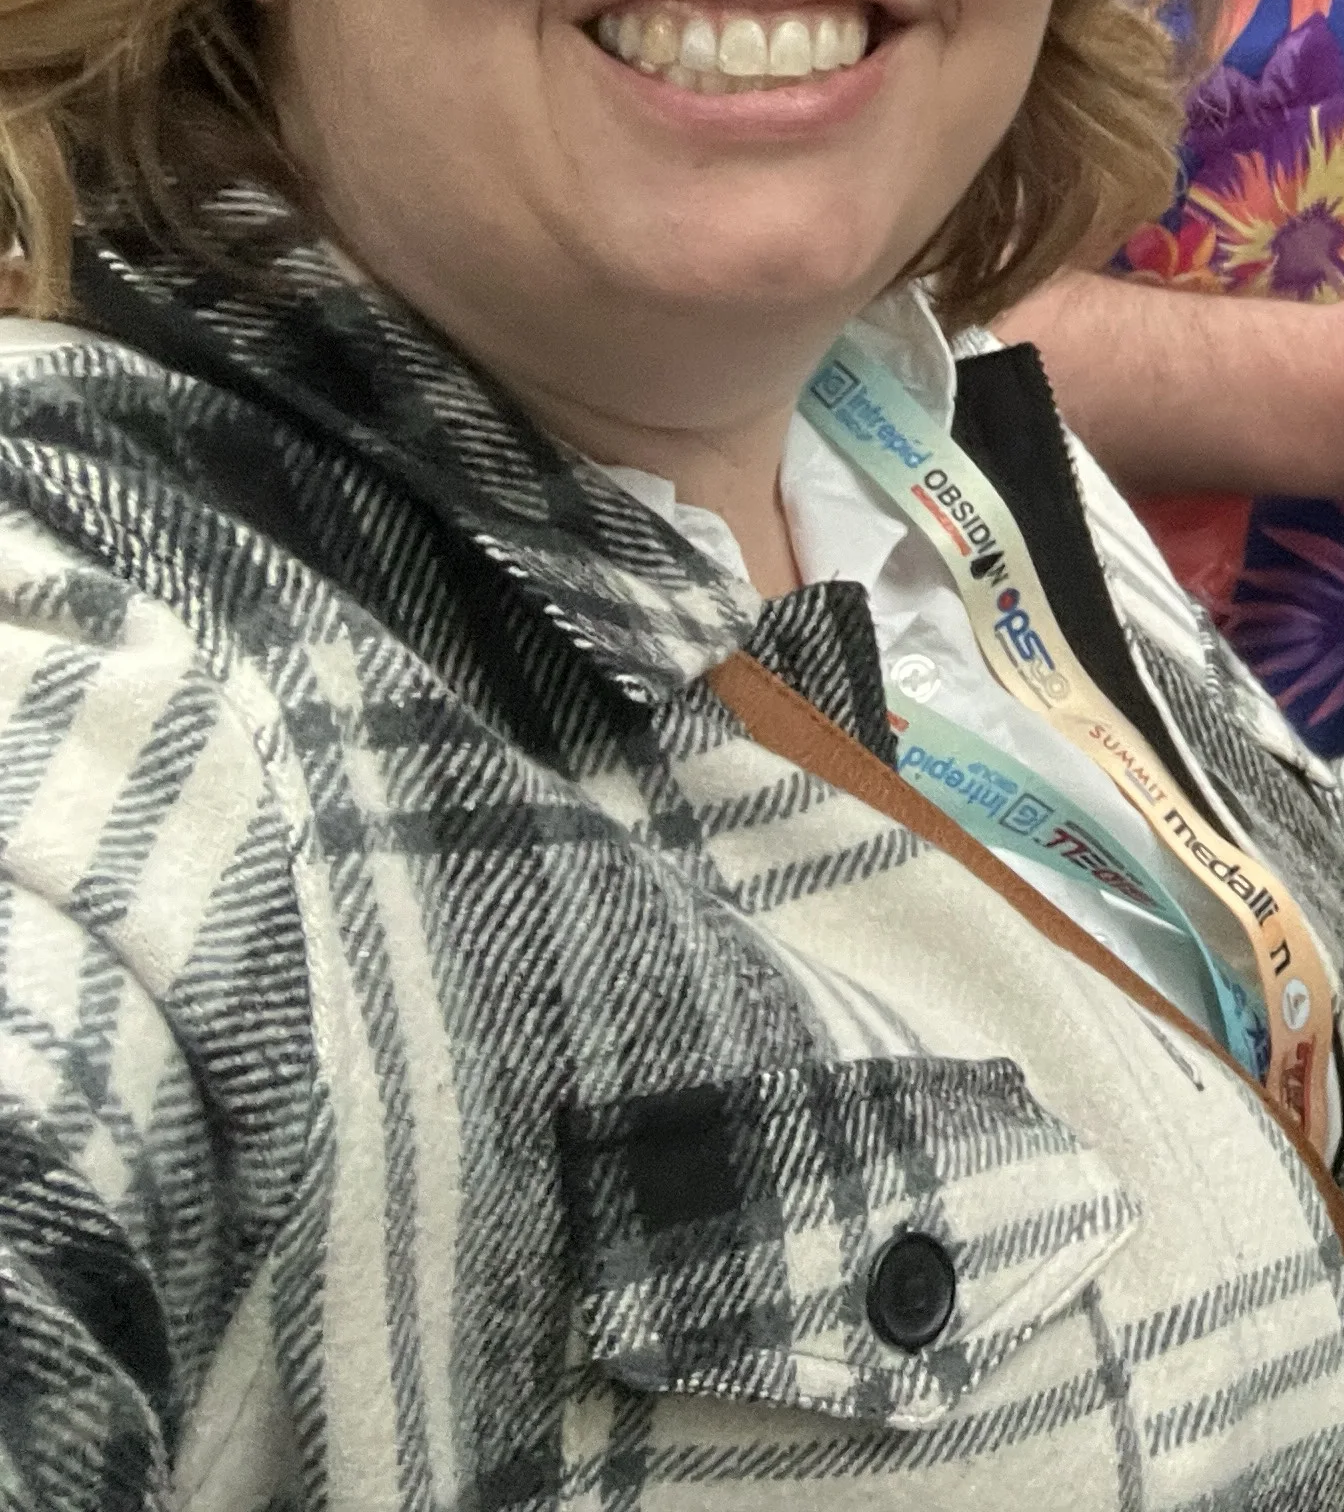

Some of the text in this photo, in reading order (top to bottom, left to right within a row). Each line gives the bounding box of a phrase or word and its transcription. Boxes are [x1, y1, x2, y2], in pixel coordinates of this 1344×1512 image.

[923, 468, 1010, 587] OBSIDIAN
[898, 745, 1009, 818] Intrepid
[1088, 724, 1169, 802] SUMMIT
